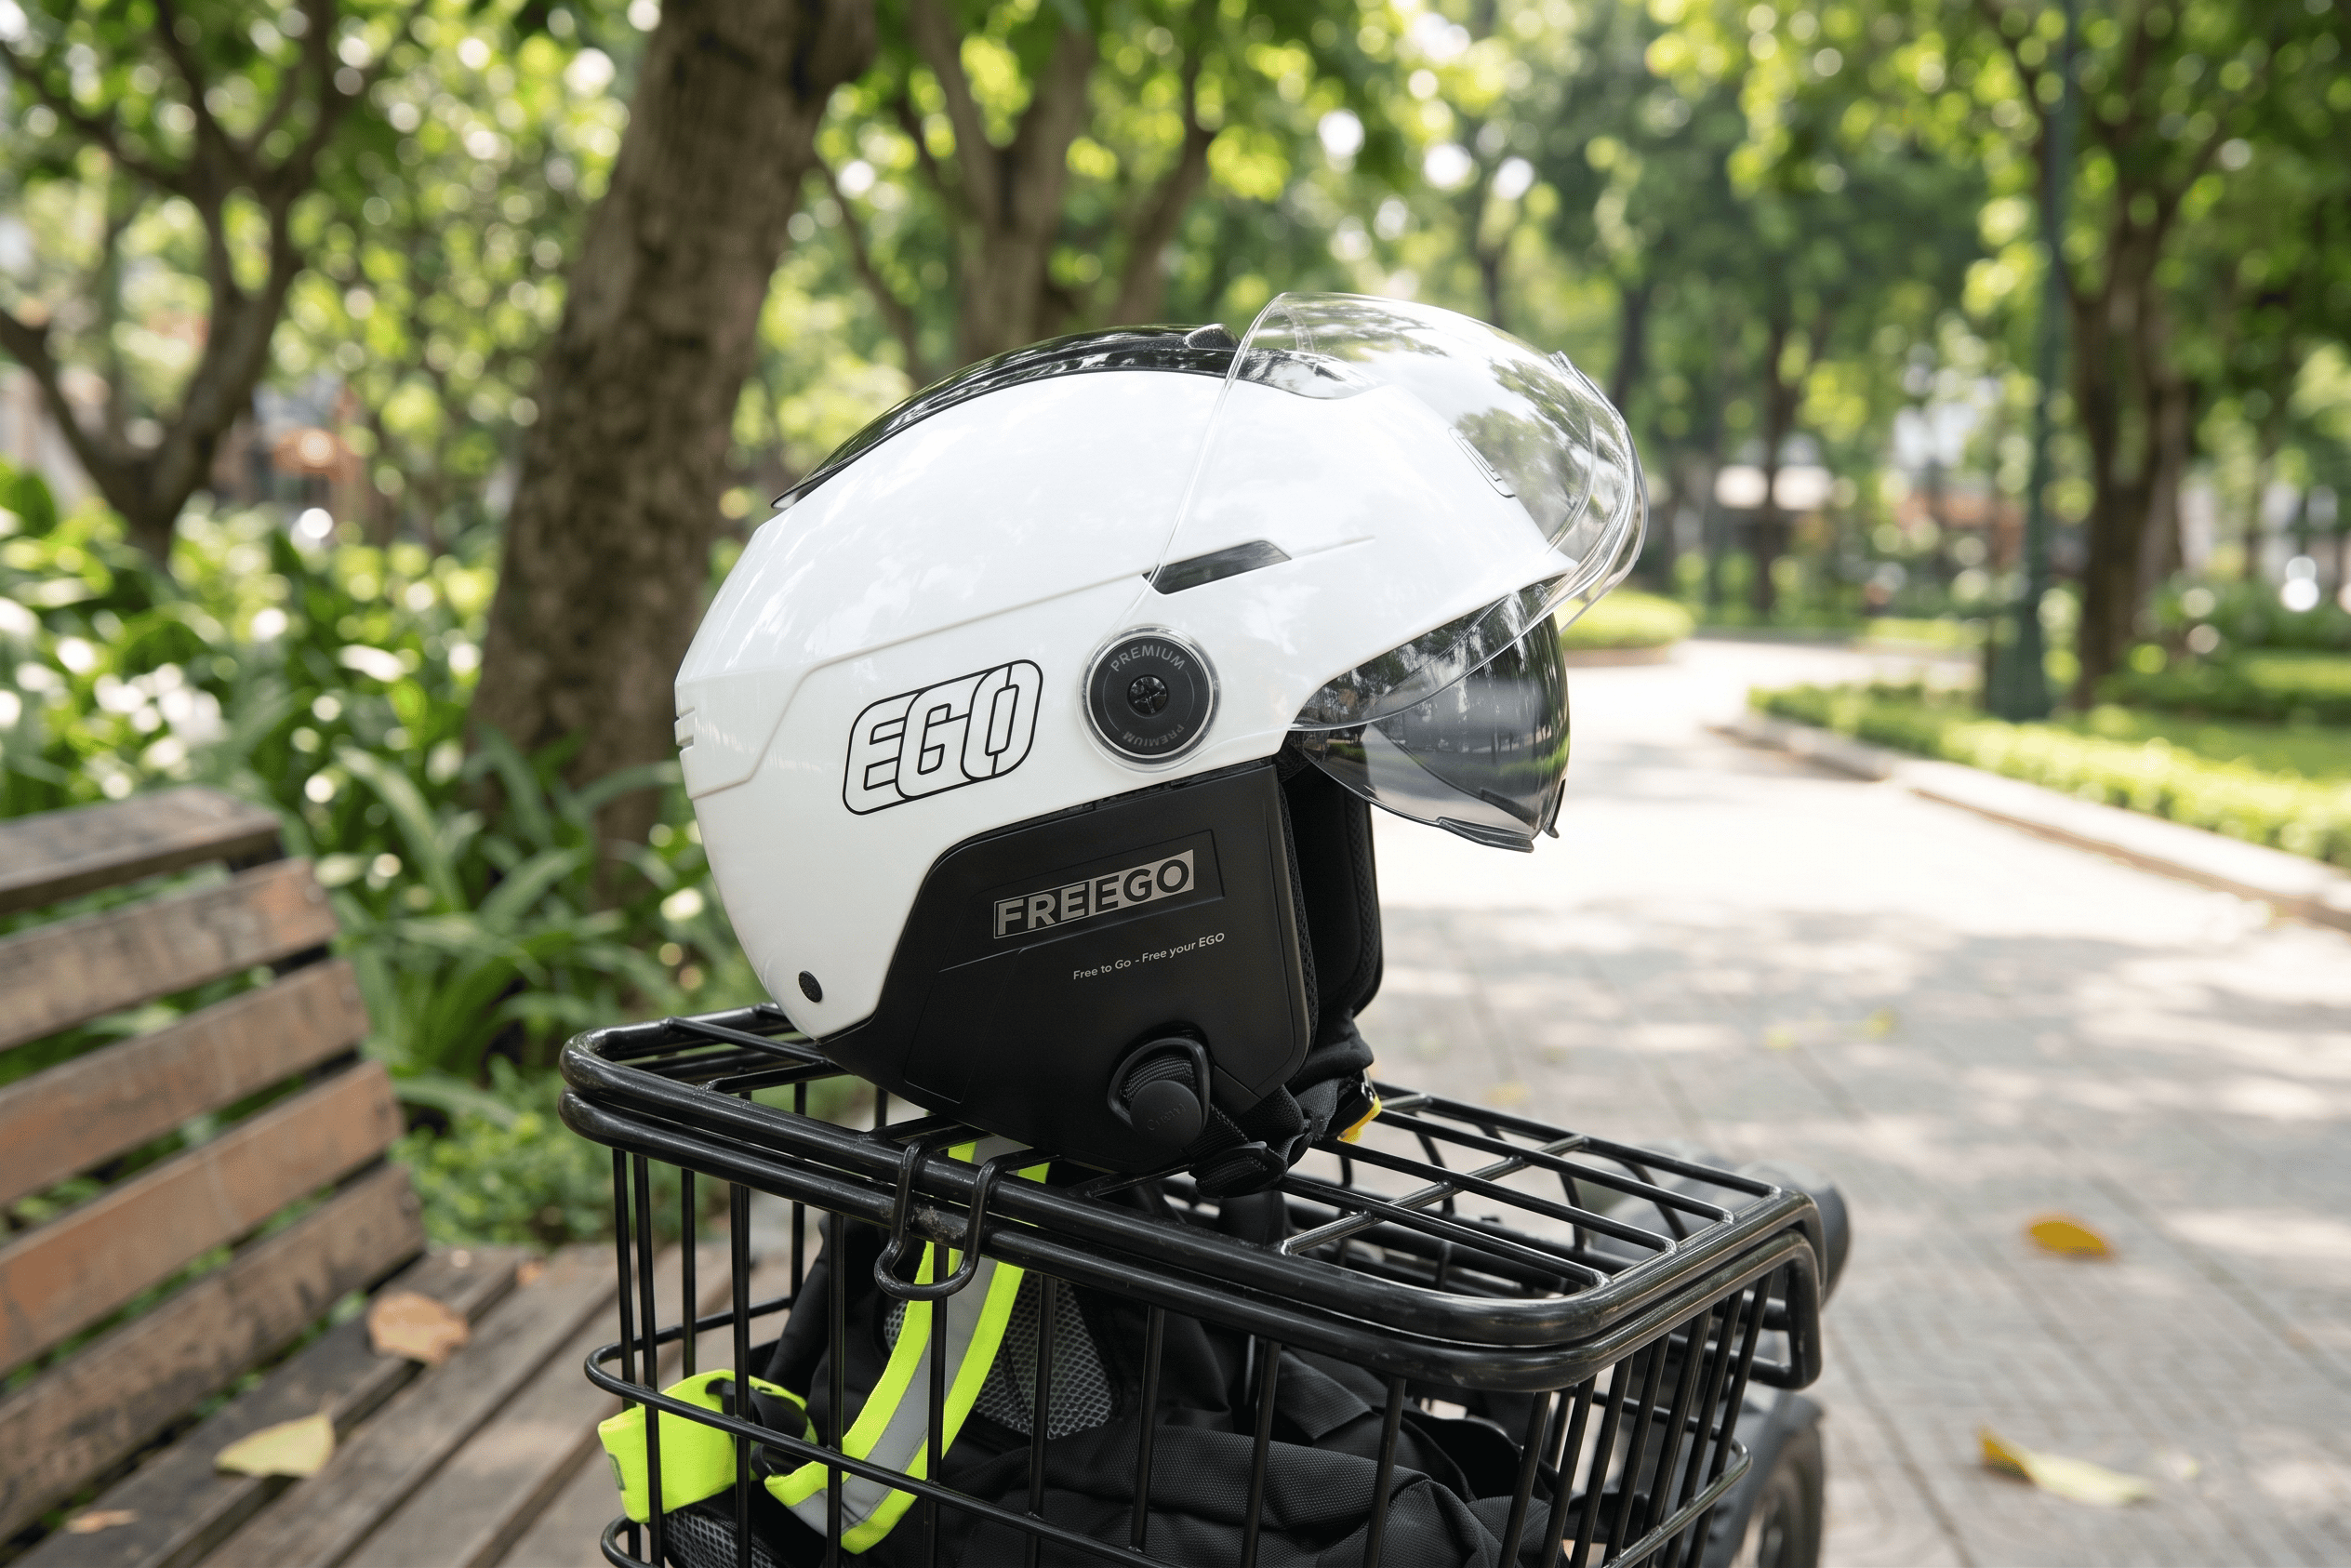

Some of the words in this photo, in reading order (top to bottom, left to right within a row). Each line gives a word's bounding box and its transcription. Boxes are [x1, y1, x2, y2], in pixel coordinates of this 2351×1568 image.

[1110, 645, 1186, 671] PREMIUM
[843, 659, 1043, 815] EGO
[1122, 724, 1185, 747] PREMIUM
[1073, 968, 1098, 980] Free
[1100, 963, 1112, 974] to
[1115, 958, 1131, 970] Go
[1142, 949, 1167, 963] Free
[1169, 941, 1196, 958] your
[1199, 932, 1225, 949] EGO
